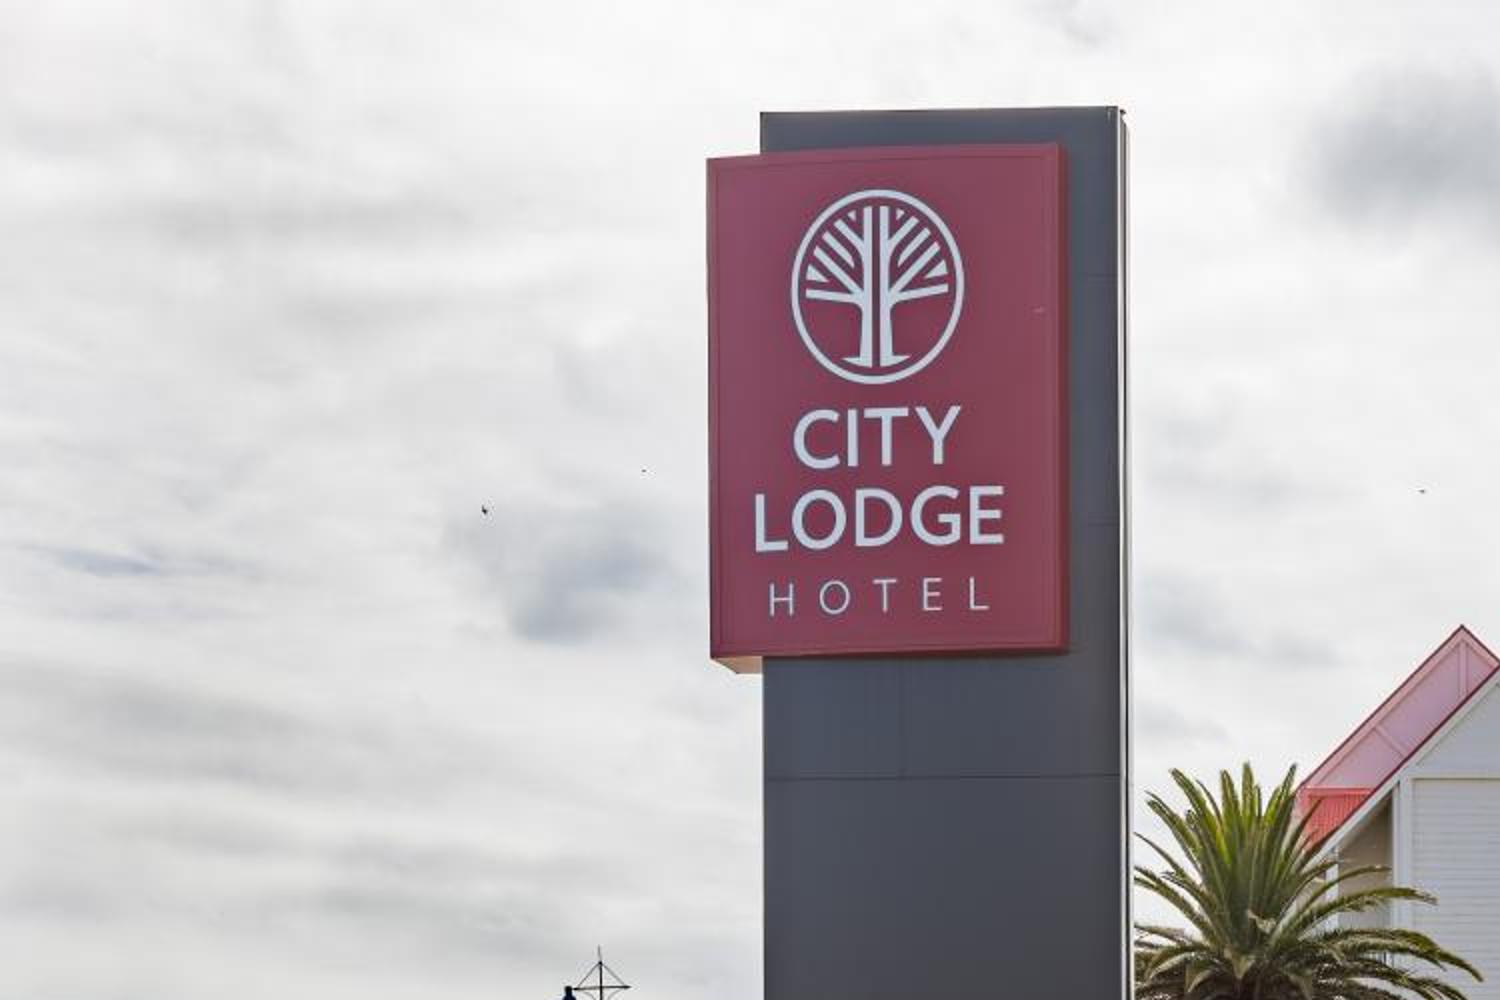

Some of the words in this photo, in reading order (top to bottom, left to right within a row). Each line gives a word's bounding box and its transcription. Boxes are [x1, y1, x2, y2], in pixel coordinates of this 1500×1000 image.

[793, 405, 961, 469] CITY
[754, 485, 1004, 552] LODGE
[769, 577, 990, 616] HOTEL
